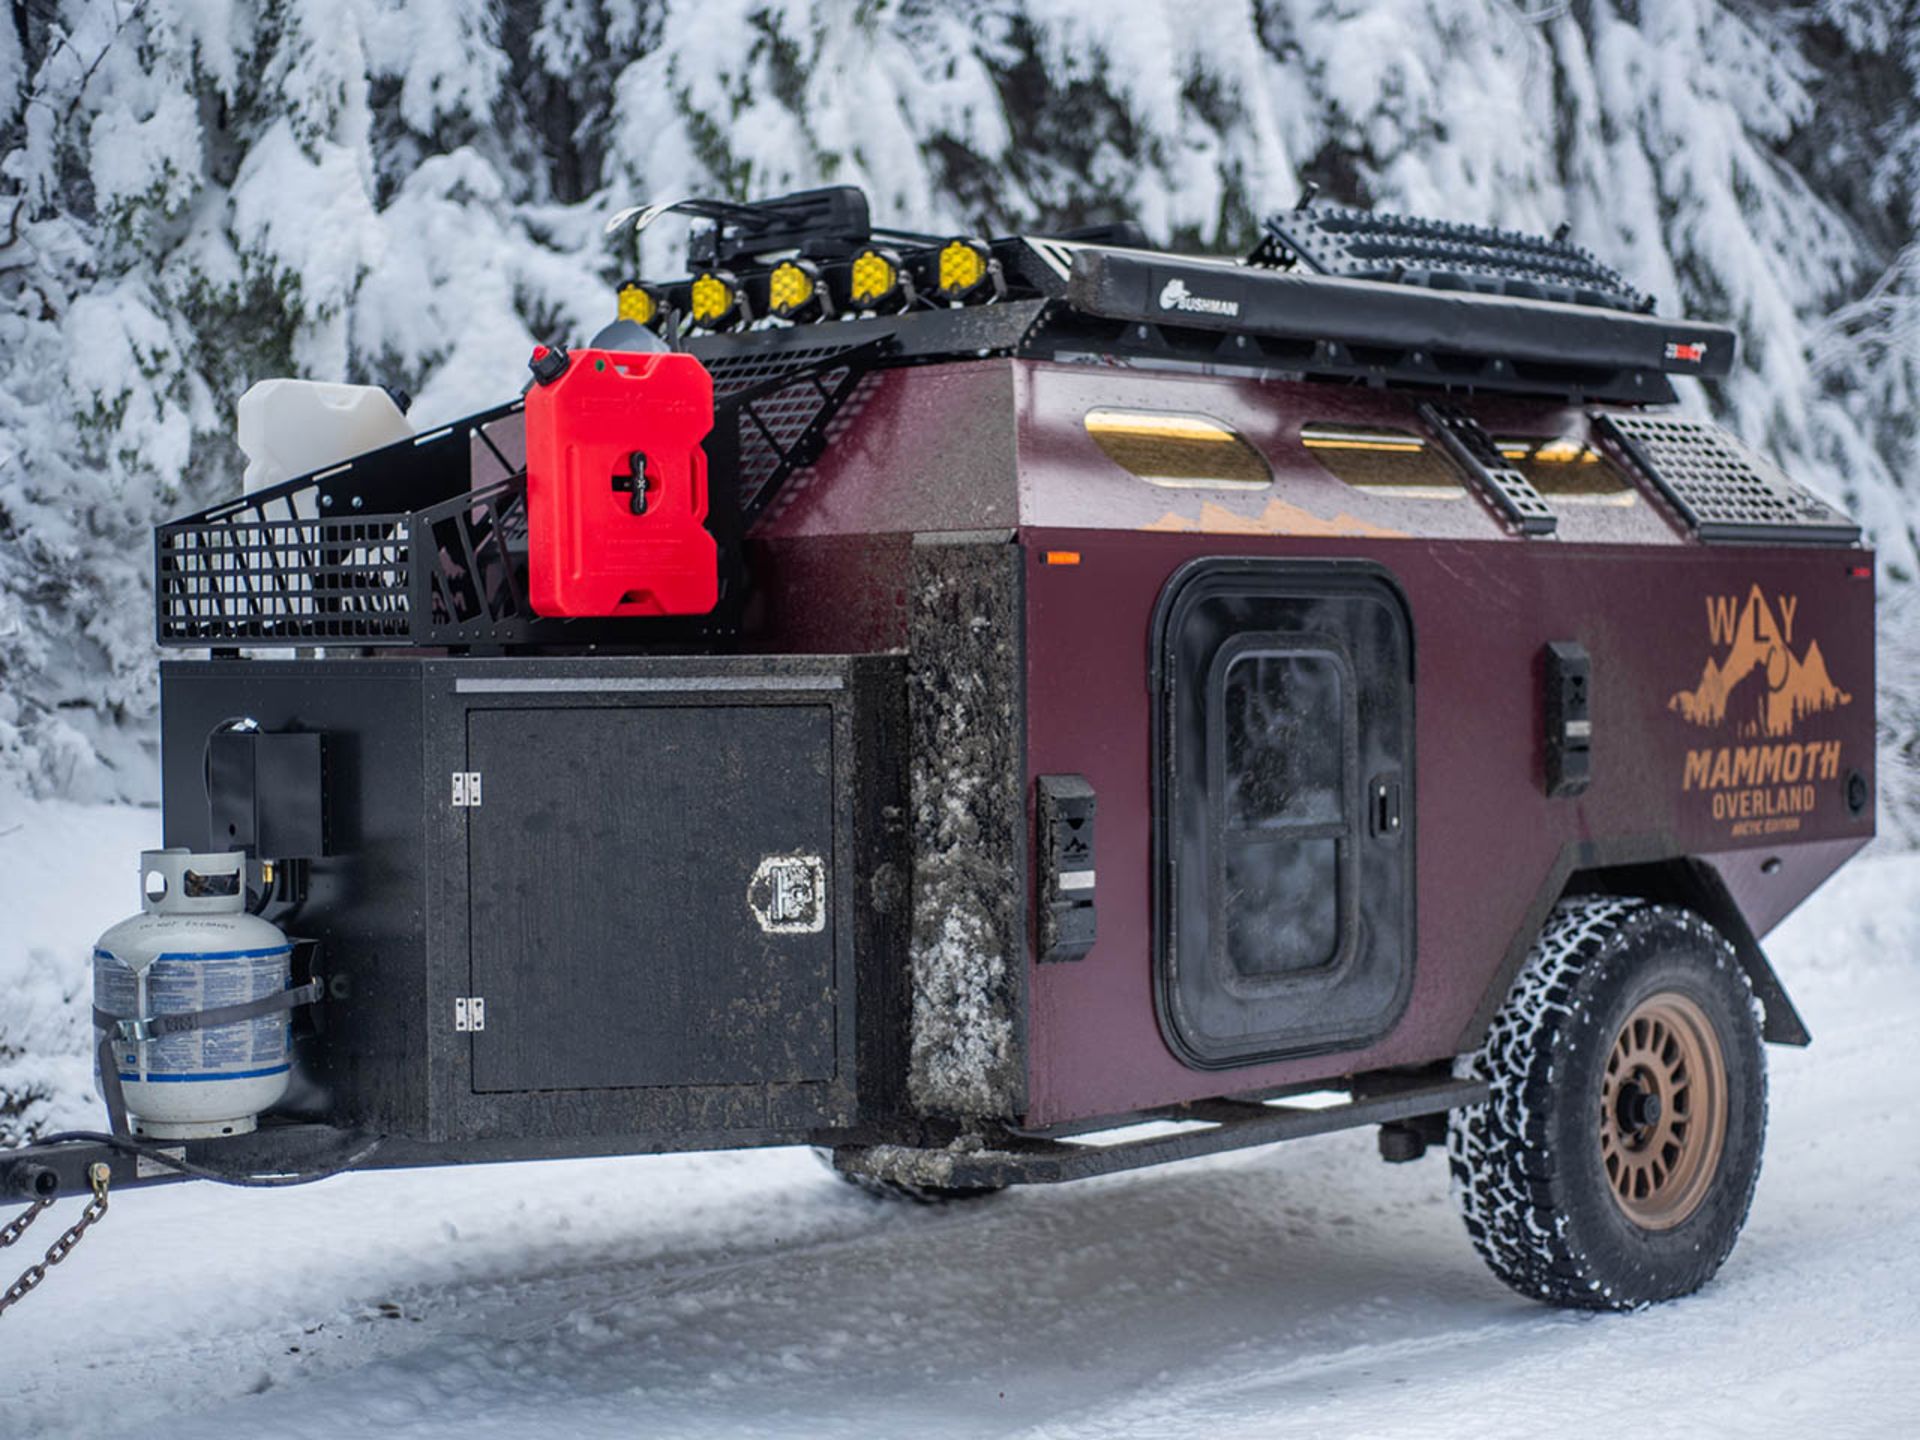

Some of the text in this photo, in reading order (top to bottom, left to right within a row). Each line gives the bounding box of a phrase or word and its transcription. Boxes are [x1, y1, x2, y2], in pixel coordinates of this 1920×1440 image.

[1177, 297, 1239, 316] BUSHMAN
[1683, 740, 1841, 791] MAMMOTH
[1713, 784, 1815, 820] OVERLAND
